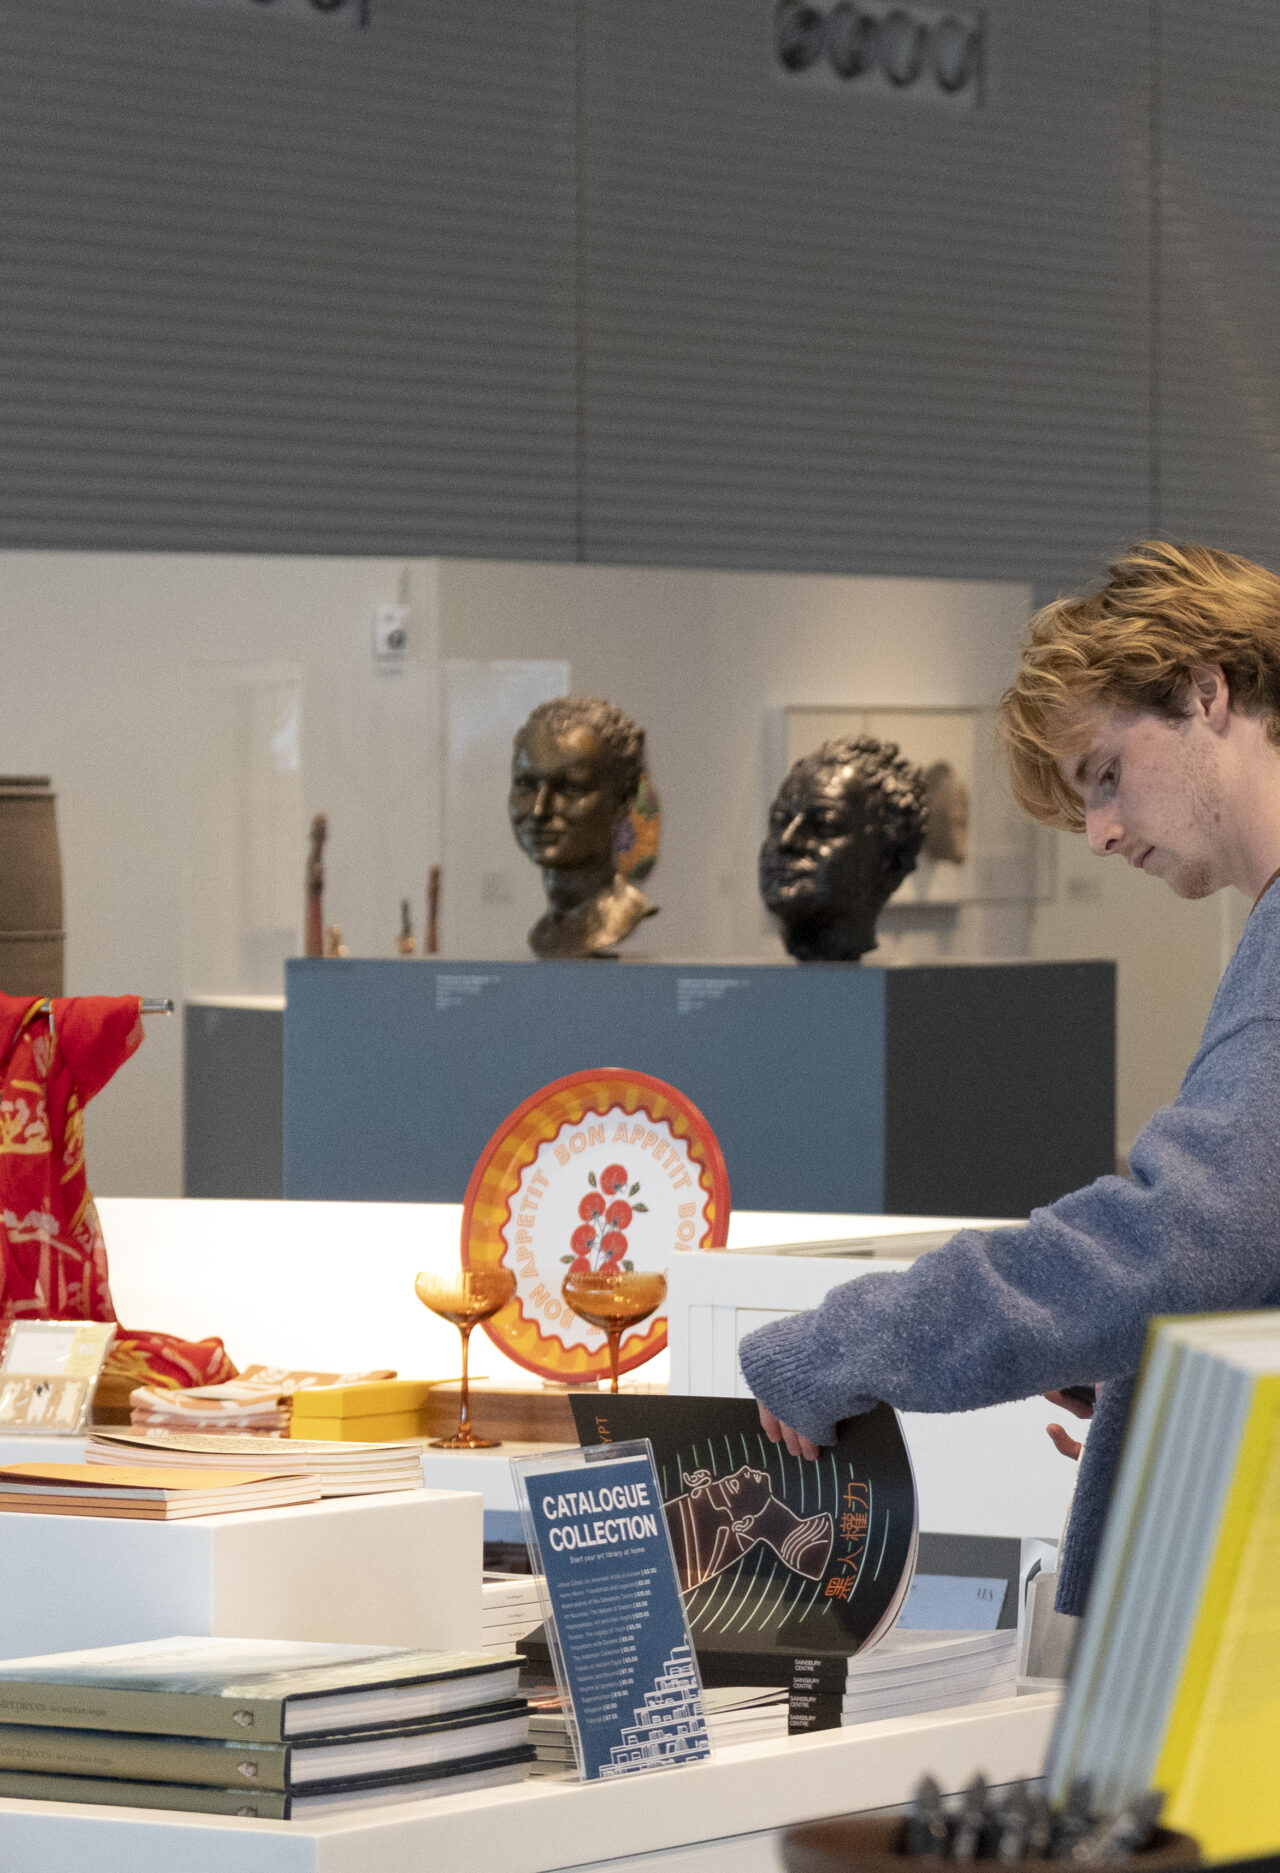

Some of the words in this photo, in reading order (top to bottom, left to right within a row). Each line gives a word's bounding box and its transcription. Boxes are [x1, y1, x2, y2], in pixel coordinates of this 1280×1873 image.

[554, 1123, 605, 1166] BON
[612, 1121, 692, 1189] APPETIT
[515, 1168, 549, 1279] APPETIT
[542, 1482, 650, 1520] CATALOGUE
[549, 1514, 658, 1552] COLLECTION
[793, 1676, 820, 1684] SAINSBURY
[789, 1720, 809, 1728] CENTRE
